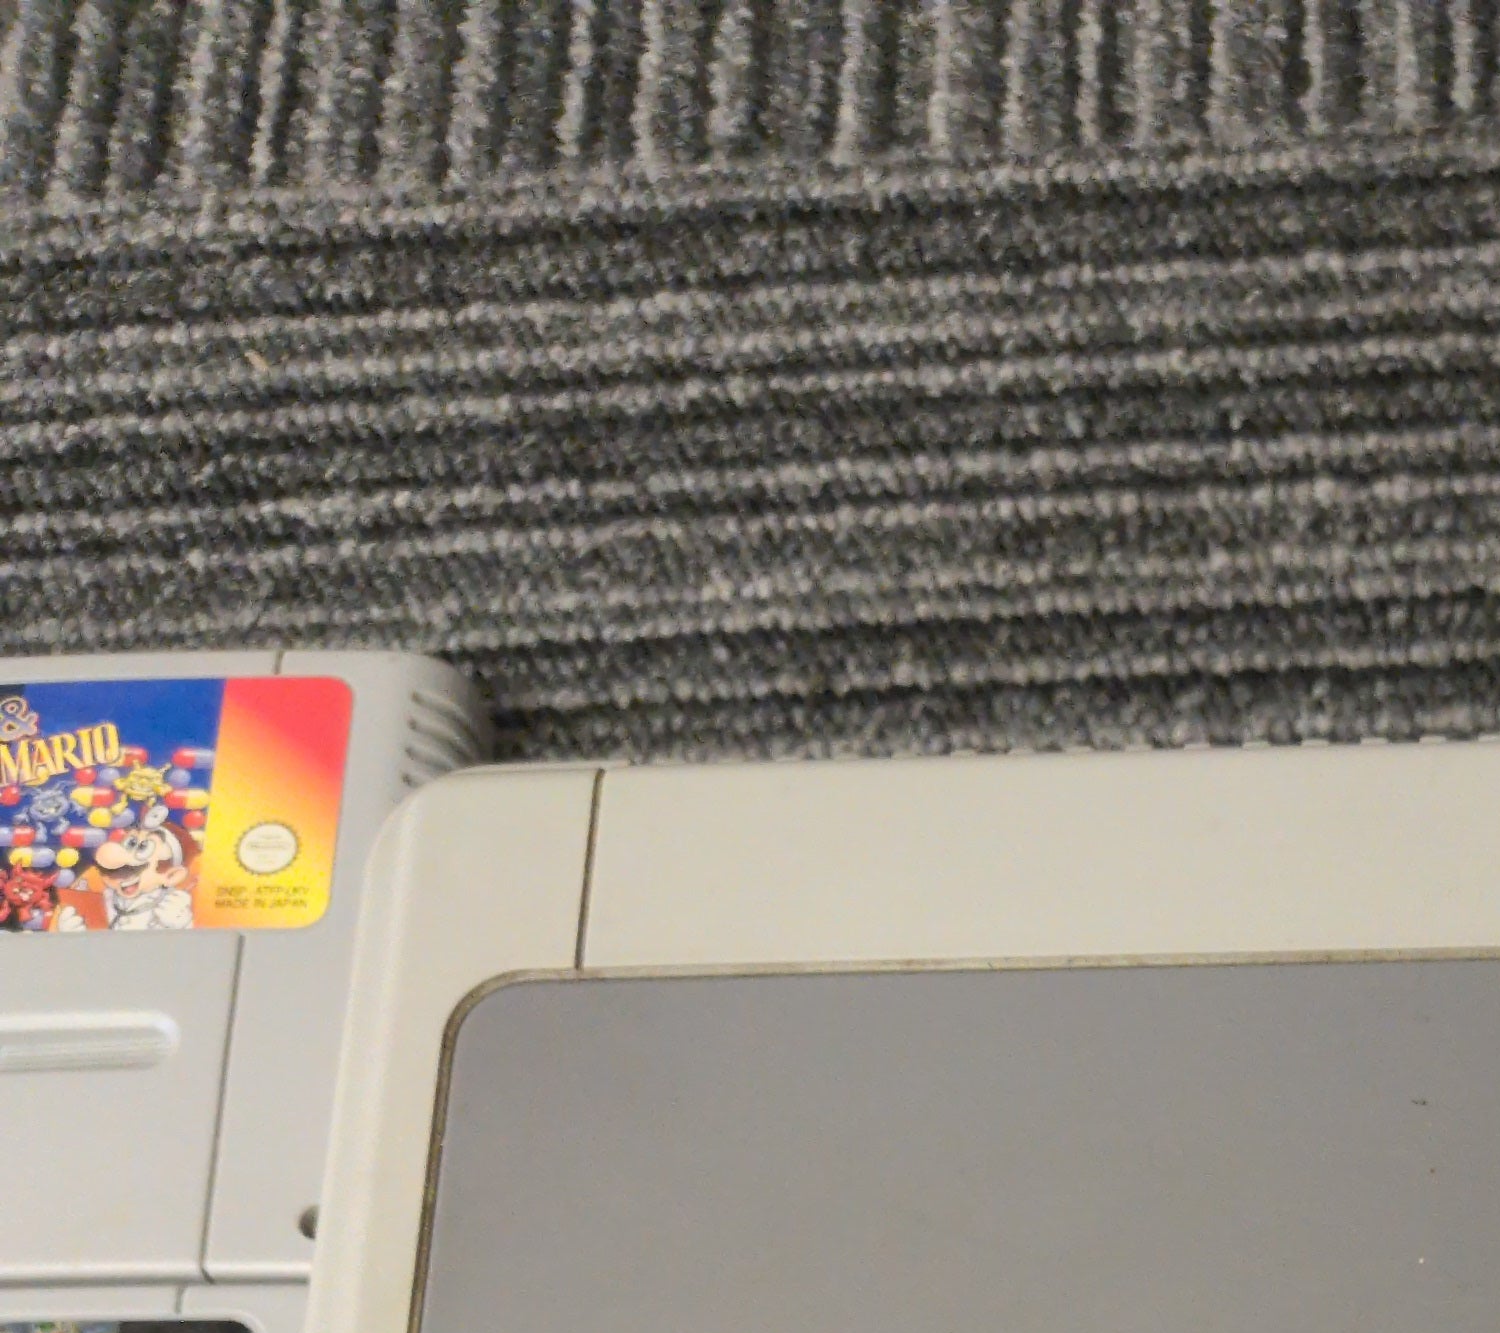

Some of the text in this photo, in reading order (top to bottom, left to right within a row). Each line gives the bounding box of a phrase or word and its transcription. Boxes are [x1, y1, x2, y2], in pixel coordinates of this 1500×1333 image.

[0, 721, 120, 787] MARIO
[214, 898, 309, 911] MADE IN JAPAN
